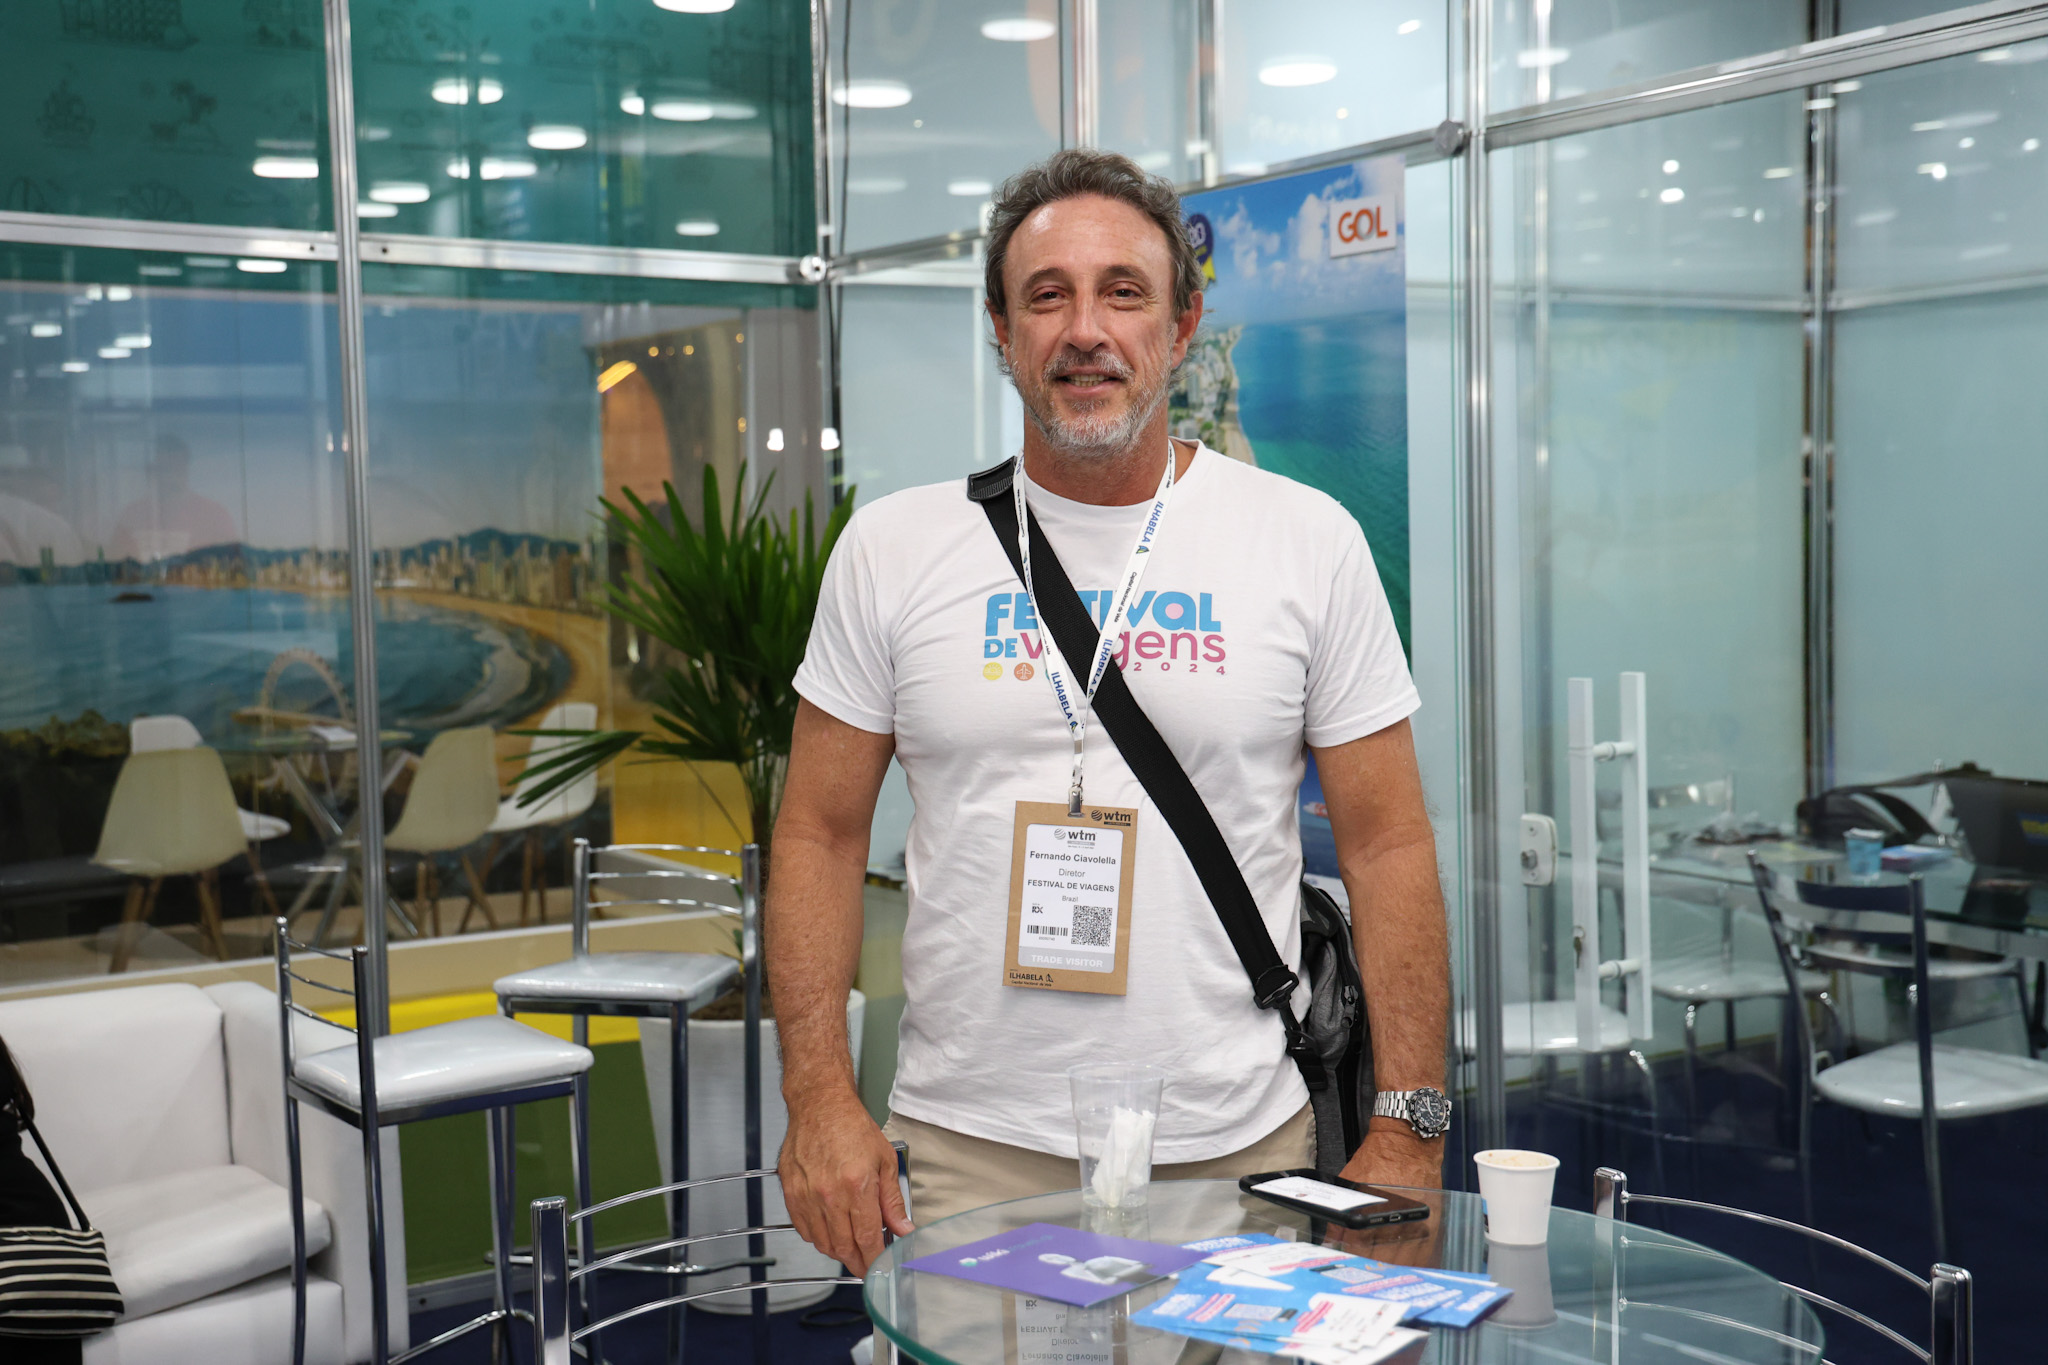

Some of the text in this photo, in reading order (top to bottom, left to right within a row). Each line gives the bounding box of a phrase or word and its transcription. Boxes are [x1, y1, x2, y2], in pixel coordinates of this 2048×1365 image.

[1338, 206, 1388, 244] GOL
[1142, 501, 1164, 543] ILHABELA
[984, 638, 1017, 659] DE
[1091, 638, 1113, 685] ILHABELA
[1051, 671, 1073, 720] ILHABELA
[1104, 810, 1131, 822] wtm
[1068, 830, 1096, 841] wtm
[1030, 851, 1116, 865] Fernando Ciavolella
[1058, 868, 1085, 878] Diretor
[1027, 880, 1114, 893] FESTIVAL DE VIAGENS
[1062, 895, 1079, 903] Brazil
[1031, 954, 1103, 968] TRADE VISITOR
[1009, 972, 1044, 981] ILHABELA
